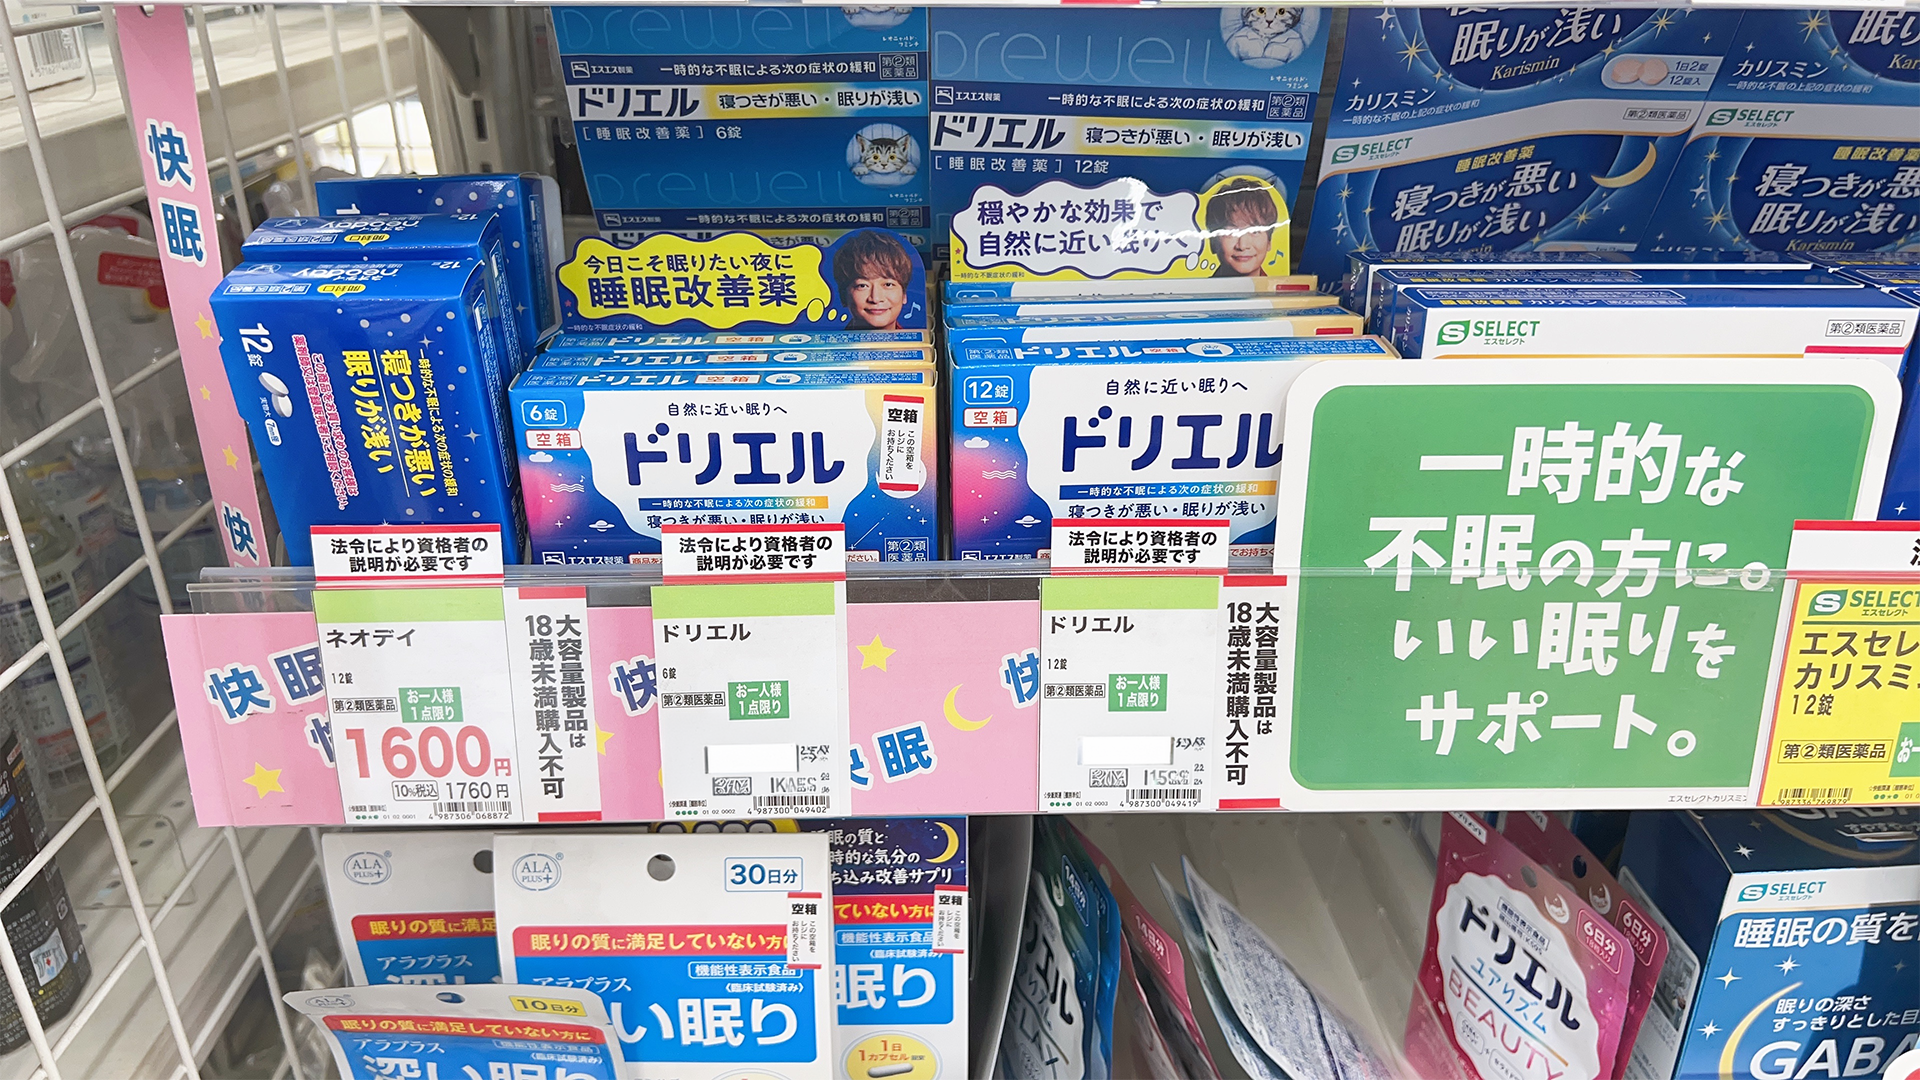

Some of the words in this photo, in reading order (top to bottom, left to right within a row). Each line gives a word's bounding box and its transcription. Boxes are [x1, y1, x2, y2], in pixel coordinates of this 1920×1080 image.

[1450, 8, 1622, 66] 眠りが浅い
[590, 65, 634, 75] エスエス製薬
[660, 62, 876, 77] 一時的な不眠による次の症状の緩和
[881, 68, 917, 79] 医薬品
[1490, 56, 1560, 81] Karismin
[1675, 61, 1709, 72] 1日2錠
[1732, 60, 1829, 79] カリスミン
[578, 87, 700, 118] ドリエル
[718, 90, 921, 110] 寝つきが悪い・眠りが浅い
[955, 91, 1001, 102] エスエス製薬
[1048, 94, 1265, 113] 一時的な不眠による次の症状の緩和
[1345, 87, 1436, 113] カリスミン
[1269, 106, 1305, 118] 医薬品
[1738, 109, 1795, 123] SELECT
[716, 126, 743, 140] 6錠
[934, 115, 1066, 150] ドリエル
[1085, 127, 1302, 149] 寝つきが悪い・眠りが浅い
[1360, 137, 1413, 156] SELECT
[1075, 159, 1110, 174] 12錠
[1455, 145, 1536, 173] 睡眠改善薬
[148, 124, 204, 261] 快眠
[1391, 161, 1577, 221] 寝つきが悪い
[686, 212, 884, 225] 一時的な不眠による次の症状の緩和
[977, 199, 1164, 226] 穏やかな効果で
[1749, 202, 1917, 236] 眠りが浅い
[1396, 202, 1547, 252] 眠りが浅い
[1785, 239, 1856, 252] Karismin
[584, 252, 793, 273] 今日こそ眠りたい夜に
[293, 267, 399, 279] neoday
[588, 274, 799, 310] 睡眠改善薬
[1473, 320, 1540, 337] SELECT
[1828, 321, 1902, 336] 第②類医薬品
[239, 323, 274, 367] 12錠
[608, 336, 710, 346] ドリエル
[1483, 337, 1526, 346] エスセレクト
[594, 355, 701, 366] ドリエル
[1015, 345, 1144, 360] ドリエル
[577, 375, 689, 386] ドリエル
[1106, 377, 1248, 396] 自然に近い眠りへ
[968, 381, 1009, 400] 12錠
[342, 350, 396, 474] 眠りが浅い
[529, 405, 559, 423] 6錠
[667, 402, 788, 417] 自然に近い眠りへ
[888, 408, 918, 424] 空箱
[973, 410, 1008, 426] 空箱
[380, 349, 437, 497] 寝つきが悪い
[418, 348, 458, 497] 一時的な不眠による次の症状の緩和
[536, 431, 573, 448] 空箱
[896, 429, 906, 453] レジに
[1062, 405, 1283, 472] ドリエル
[623, 423, 845, 486] ドリエル
[885, 428, 896, 481] お持ちください
[905, 430, 916, 470] この空箱を
[1419, 421, 1746, 506] 一時的な
[1078, 483, 1259, 498] 一時的な不眠による次の症状の緩和
[652, 498, 816, 510] 一時的な不眠による次の症状の緩和
[1068, 501, 1266, 519] 寝つきが悪い・眠りが浅い
[331, 536, 488, 555] 法令により資格者の
[679, 535, 832, 554] 法令により資格者の
[886, 540, 927, 553] 第②類
[1068, 530, 1217, 547] 法令により資格者の
[349, 556, 473, 573] 説明が必要です
[696, 553, 817, 572] 説明が必要です
[1084, 548, 1200, 565] 説明が必要です
[1363, 514, 1771, 598] 不眠の方に。
[1861, 608, 1908, 617] エスセレクト
[663, 623, 751, 643] ドリエル
[1050, 616, 1135, 635] ドリエル
[326, 628, 416, 648] ネオデイ
[1393, 602, 1736, 679] いい眠りを
[662, 667, 677, 680] 6錠
[1047, 658, 1068, 671] 12錠
[1254, 602, 1280, 735] 大容量製品は
[331, 672, 353, 685] 12錠
[556, 614, 589, 748] 大容量製品は
[1115, 675, 1161, 691] お一人様
[1793, 662, 1920, 690] カリスミ
[407, 689, 455, 705] お一人様
[735, 682, 782, 698] お一人様
[1046, 685, 1105, 698] 第②類医薬品
[1226, 602, 1253, 785] 18歳未満購入不可
[334, 698, 396, 713] 第②類医薬品
[525, 614, 565, 799] 18歳未満購入不可
[662, 692, 725, 707] 第②類医薬品
[738, 699, 782, 716] 1点限り
[1117, 692, 1160, 708] 1点限り
[1792, 694, 1834, 716] 12錠
[410, 706, 455, 721] 1点限り
[1405, 689, 1697, 758] サポート。
[1783, 743, 1887, 760] 第②類医薬品
[394, 783, 438, 798] 10%税込
[756, 807, 790, 815] 987300
[793, 806, 828, 814] 049402
[1129, 800, 1161, 808] 987300
[352, 859, 382, 871] ALA
[521, 861, 553, 873] ALA
[730, 863, 799, 885] 30日分
[1769, 881, 1826, 896] SELECT
[791, 903, 818, 915] 空箱
[939, 894, 963, 906] 空箱
[370, 918, 496, 936] 眠りの質に満足
[1622, 911, 1652, 949] 6日分
[1734, 912, 1920, 948] 睡眠の質を
[1582, 921, 1617, 957] 6日分
[377, 954, 473, 971] アラプラス
[1459, 896, 1580, 1031] ドリエル
[1470, 957, 1547, 1034] ユアリズム
[1775, 995, 1872, 1014] 眠りの深さ
[517, 998, 579, 1014] 10日分
[341, 1018, 592, 1042] 眠りの質に満足していない方に
[1449, 968, 1564, 1080] BEAUTY
[1773, 1009, 1920, 1033] すっきりとした目
[352, 1038, 446, 1054] アラプラス
[881, 1040, 902, 1052] 1日
